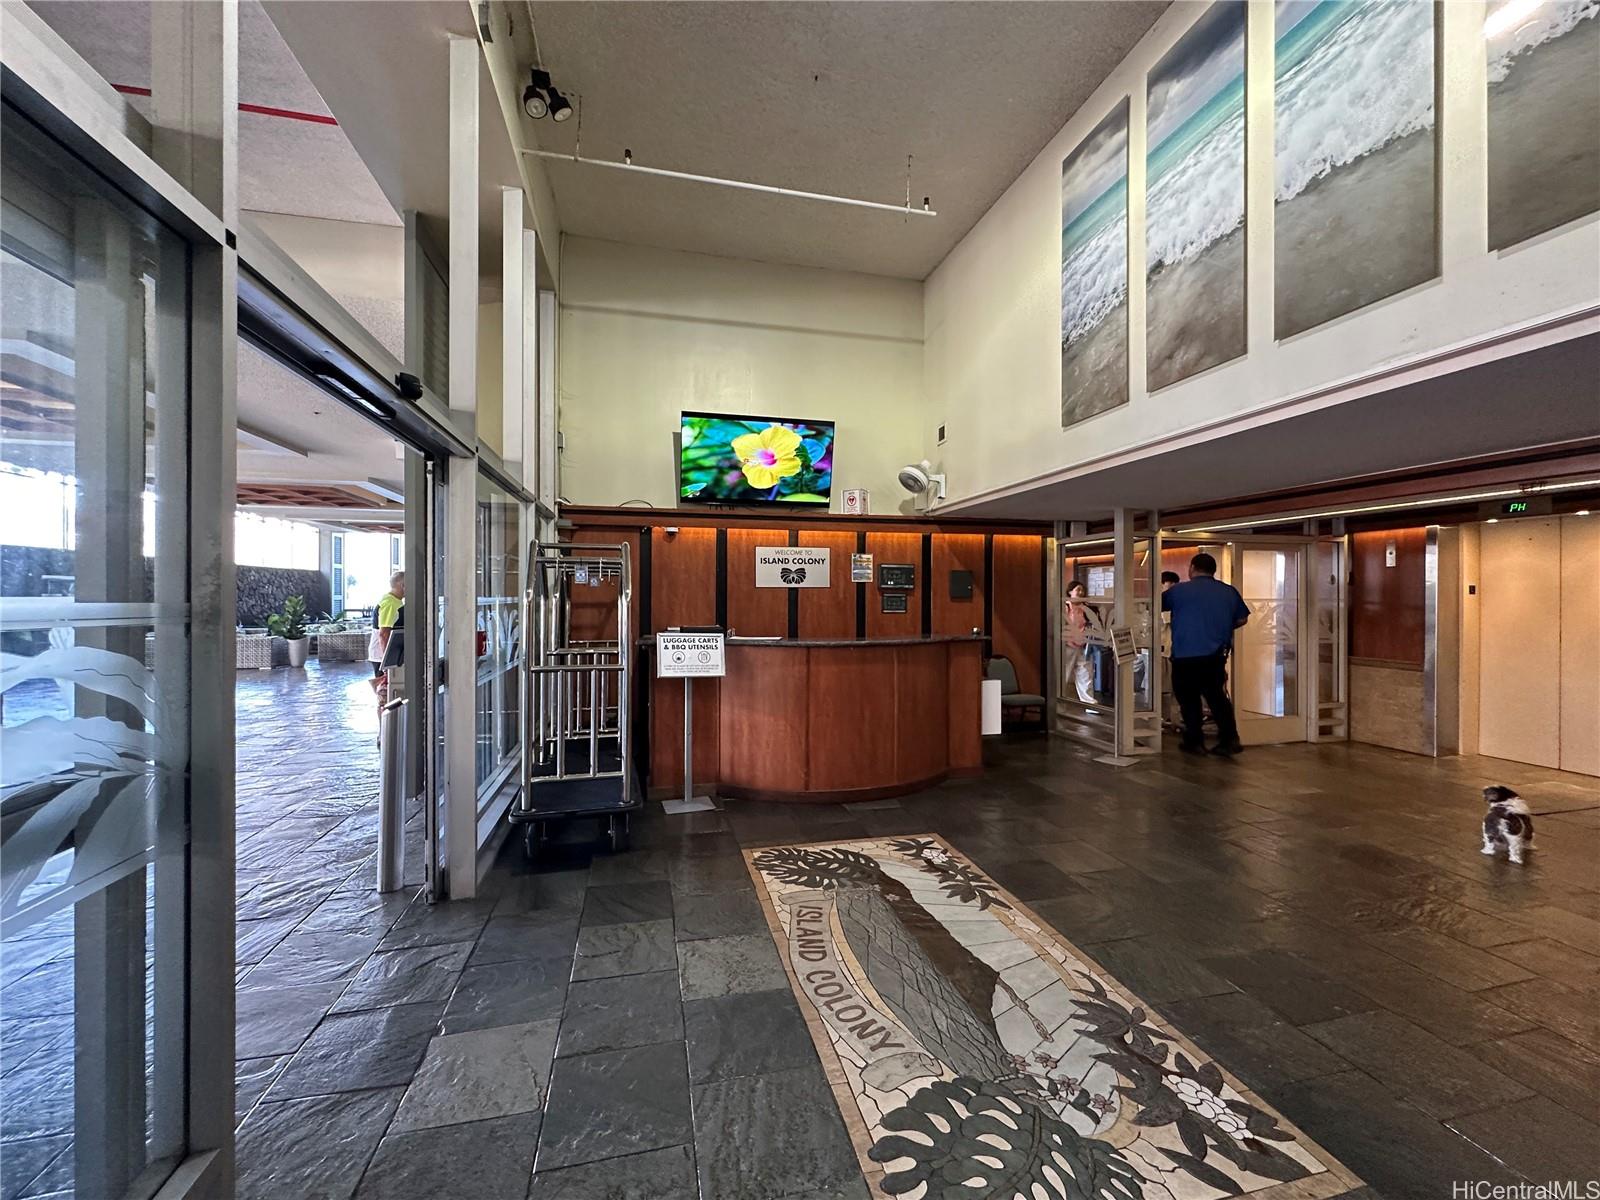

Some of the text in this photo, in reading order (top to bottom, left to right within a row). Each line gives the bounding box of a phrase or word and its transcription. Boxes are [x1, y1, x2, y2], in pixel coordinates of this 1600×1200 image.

[1509, 503, 1527, 513] PH
[760, 557, 826, 565] ISLAND COLONY
[796, 905, 906, 1052] ISLAND COLONY
